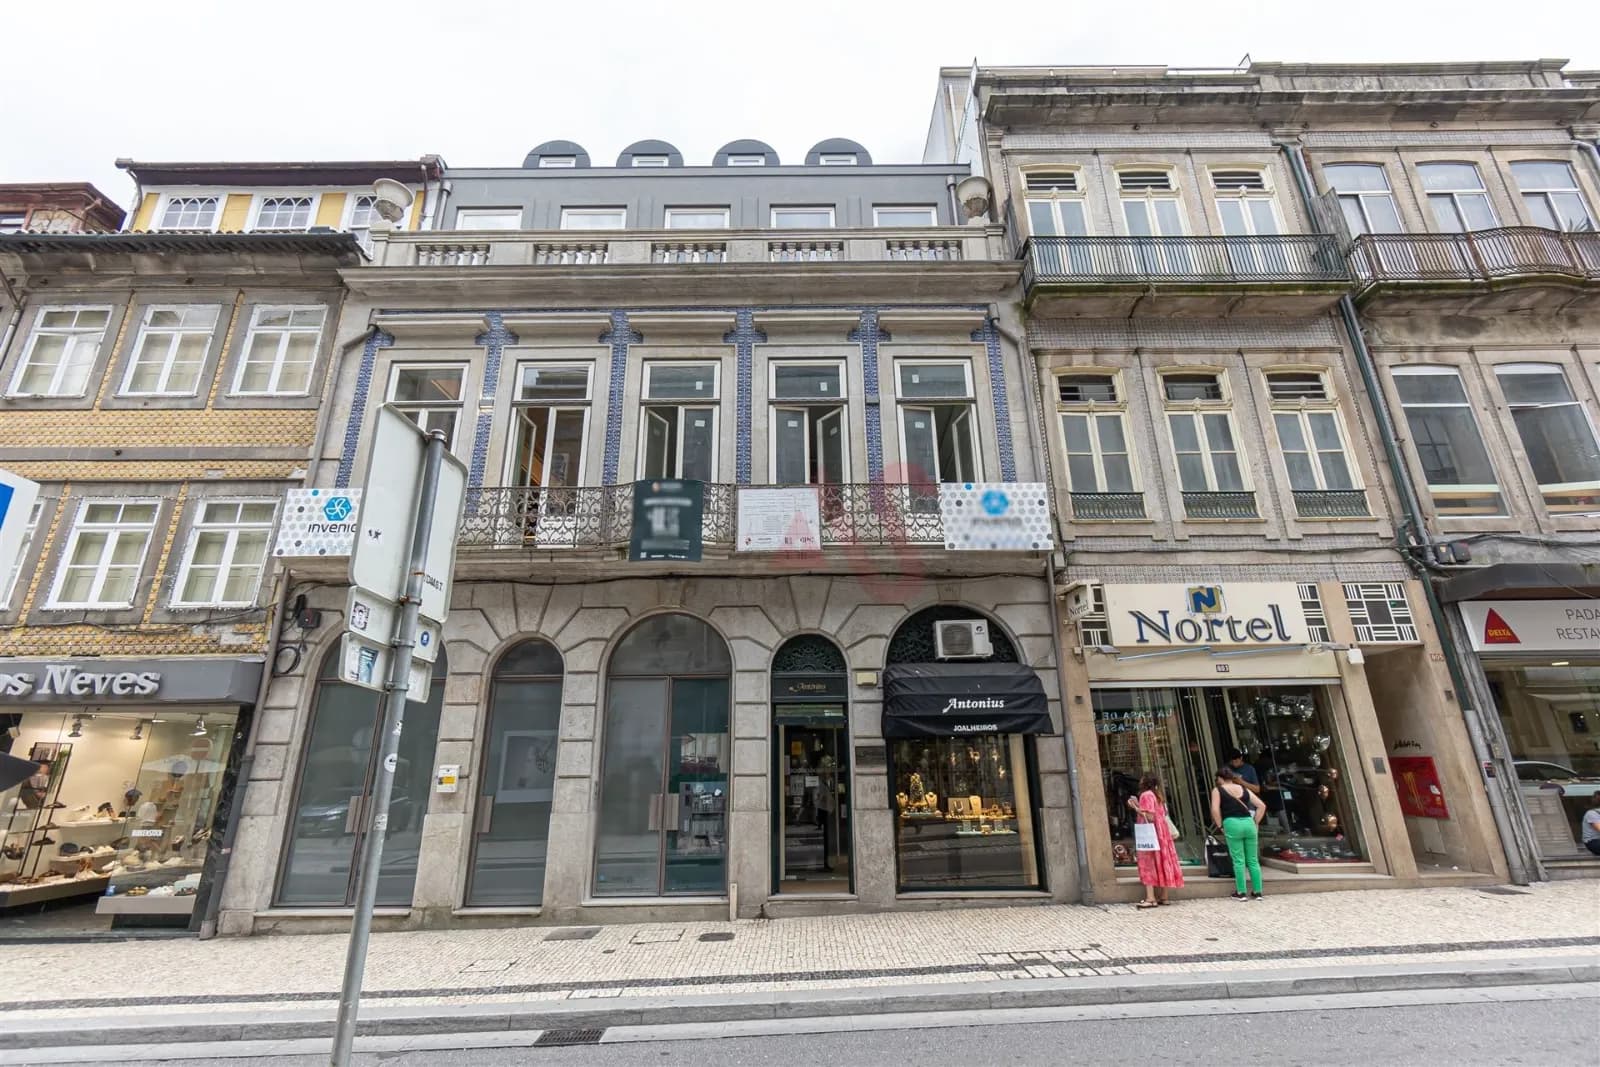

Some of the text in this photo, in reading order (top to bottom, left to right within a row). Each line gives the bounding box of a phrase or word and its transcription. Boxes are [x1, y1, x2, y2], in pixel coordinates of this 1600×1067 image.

[1069, 600, 1089, 618] Nortel
[1128, 604, 1292, 643] Nortel
[1488, 629, 1512, 637] DELTA
[37, 665, 160, 697] Neves
[942, 697, 1004, 714] Antonius
[953, 724, 998, 732] JOALHEIROS
